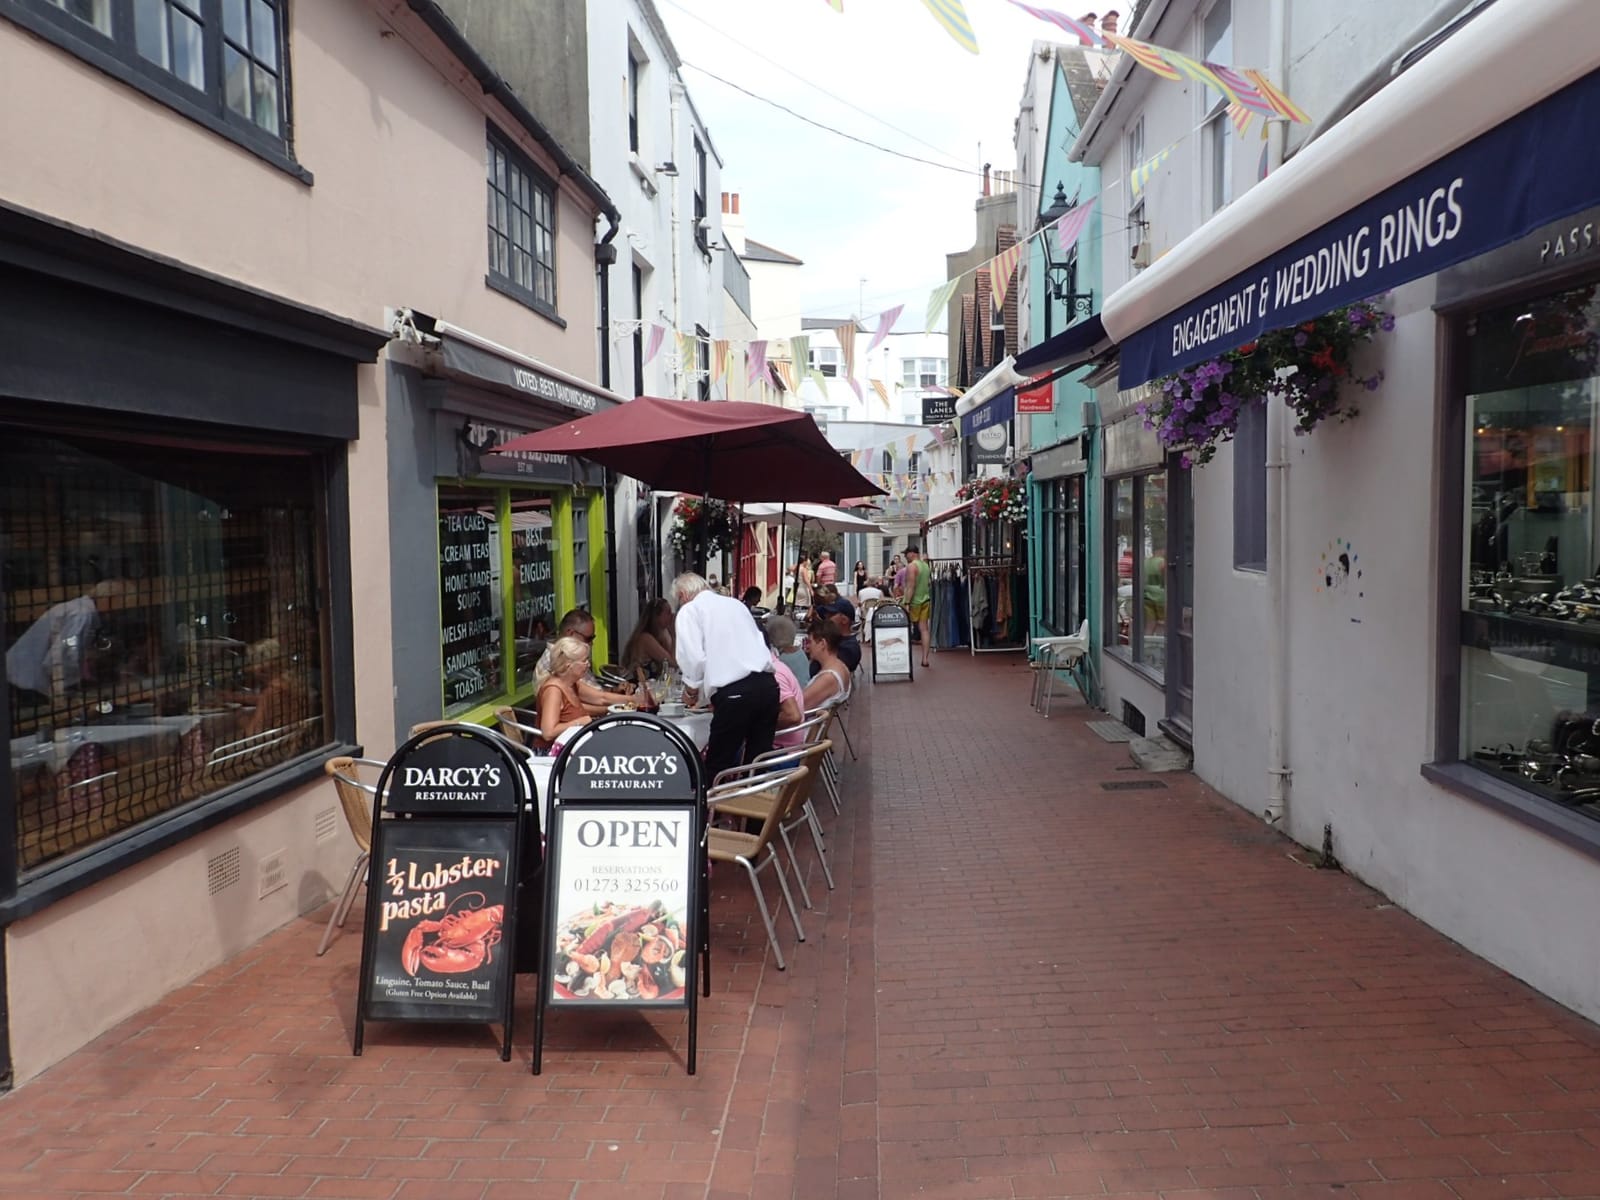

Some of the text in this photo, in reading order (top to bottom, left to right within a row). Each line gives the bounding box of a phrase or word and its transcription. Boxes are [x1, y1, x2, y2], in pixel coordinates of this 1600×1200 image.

[1172, 178, 1464, 357] ENGAGEMENT & WEDDING RINGS
[540, 377, 557, 397] BEST
[556, 383, 583, 406] SANDWICH
[582, 393, 597, 410] SHOP
[447, 514, 486, 533] TEA CAKES
[526, 527, 544, 547] BEST
[444, 542, 489, 562] CREAM TEAS
[445, 570, 491, 593] HOME MADE
[520, 561, 551, 584] ENGLISH
[457, 591, 481, 611] SOUPS
[515, 593, 556, 621] BREAKFAST
[443, 623, 467, 644] WELSH
[577, 752, 678, 775] DARCY'S
[405, 764, 501, 787] DARCY'S
[590, 780, 664, 789] RESTAURANT
[415, 791, 487, 801] RESTAURANT
[577, 819, 681, 848] OPEN
[409, 856, 500, 890] Lobster
[592, 865, 662, 874] RESERVATIONS
[574, 879, 679, 893] 01273 325560
[380, 891, 446, 931] pasta
[376, 976, 490, 990] Linguine, Tomato Sauce, Basil
[385, 988, 410, 998] (Gluten
[424, 990, 447, 1000] Option
[448, 991, 478, 1000] Available)
